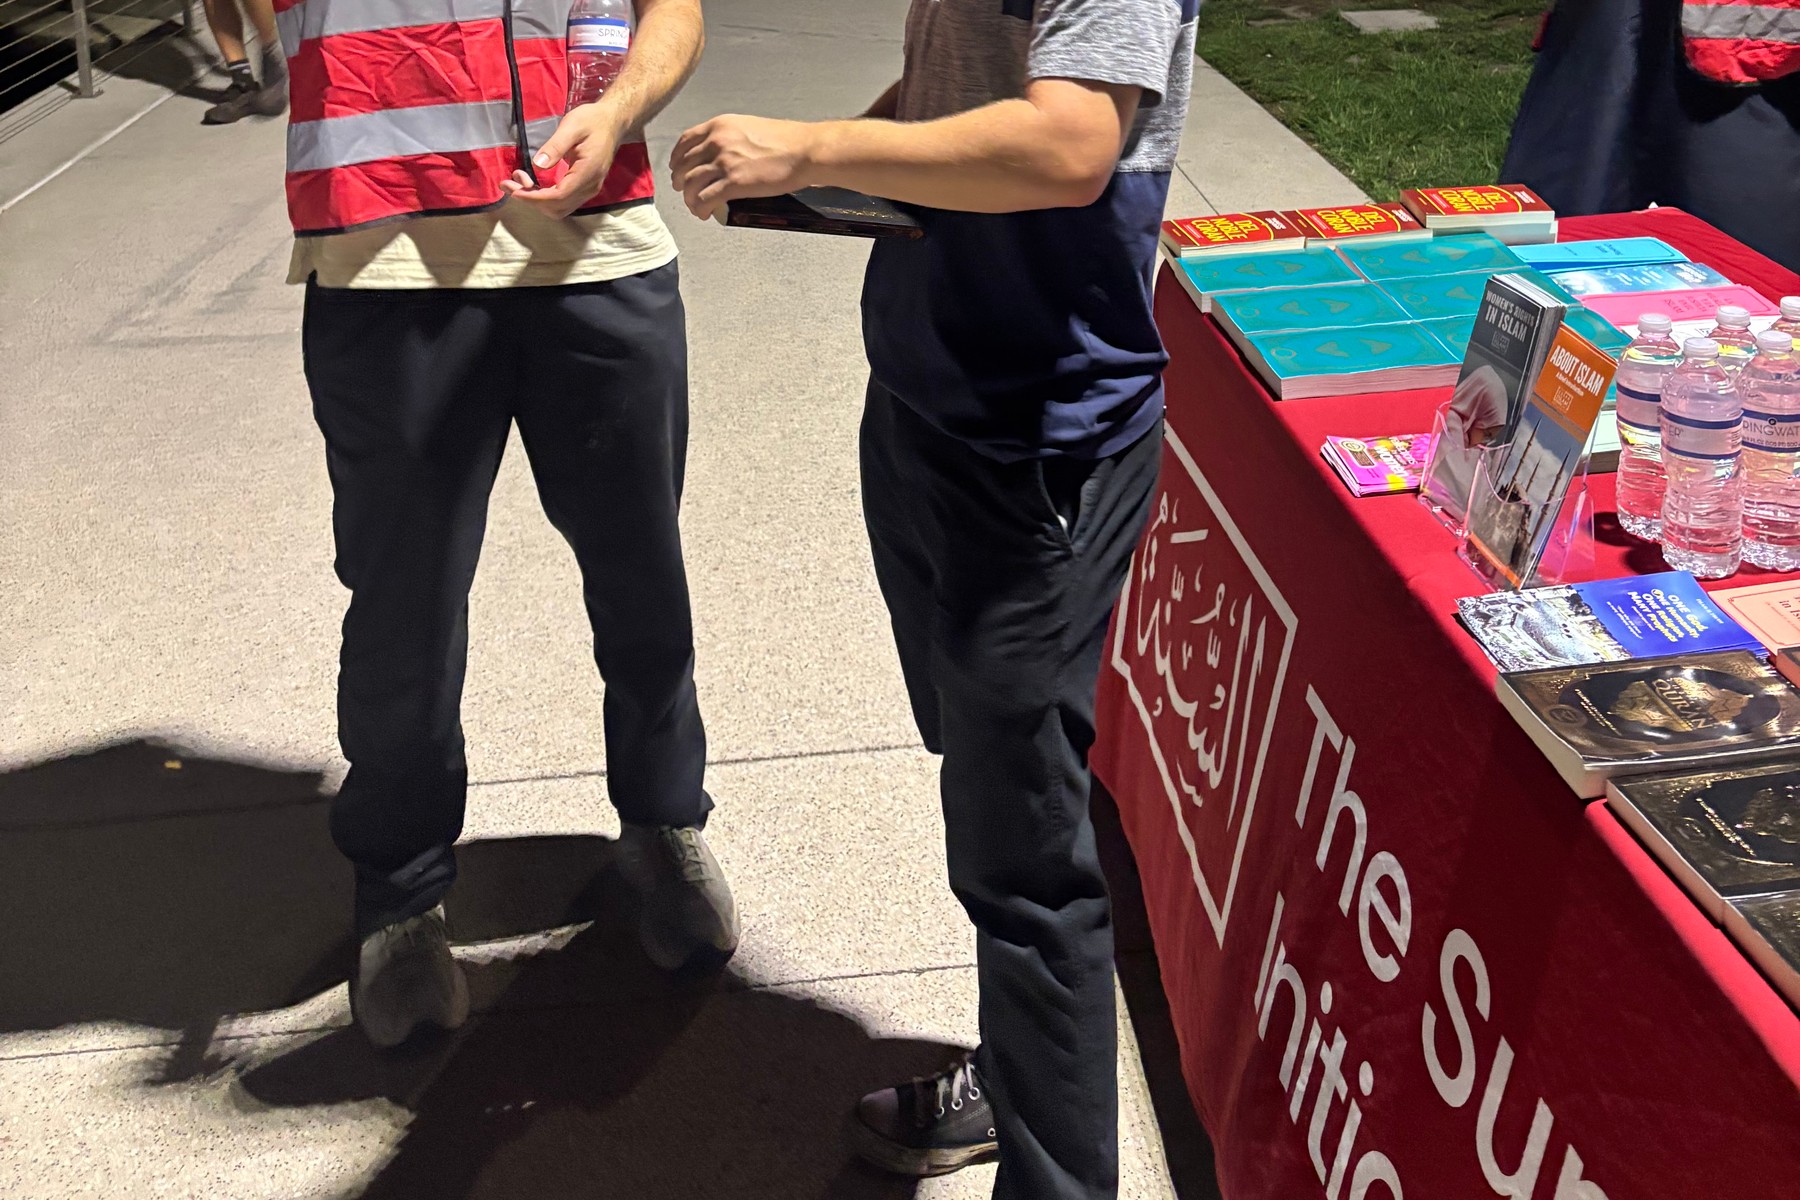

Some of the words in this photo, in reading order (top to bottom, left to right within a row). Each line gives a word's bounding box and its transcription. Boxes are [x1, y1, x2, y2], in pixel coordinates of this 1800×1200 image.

[1438, 190, 1475, 212] CORAN
[1457, 189, 1495, 211] NOBLE
[1483, 191, 1507, 205] DEL
[1210, 218, 1248, 240] NOBLE
[1234, 220, 1260, 234] DEL
[1317, 210, 1355, 233] CORAN
[1335, 209, 1374, 231] NOBLE
[1362, 211, 1386, 225] DEL
[1191, 219, 1228, 242] CORAN
[1486, 290, 1514, 314] WOMEN'S
[1513, 304, 1535, 327] RIGHTS
[1485, 305, 1499, 323] IN
[1498, 312, 1528, 343] ISLAM
[1549, 345, 1580, 377] ABOUT
[1575, 362, 1605, 397] ISLAM
[1742, 419, 1800, 437] RINGWAT
[1642, 593, 1661, 610] ONE
[1651, 588, 1671, 606] ONE
[1668, 594, 1692, 613] ONE
[1779, 600, 1791, 608] in
[1627, 591, 1652, 613] MANY
[1646, 613, 1679, 642] Prophets
[1295, 683, 1412, 983] The
